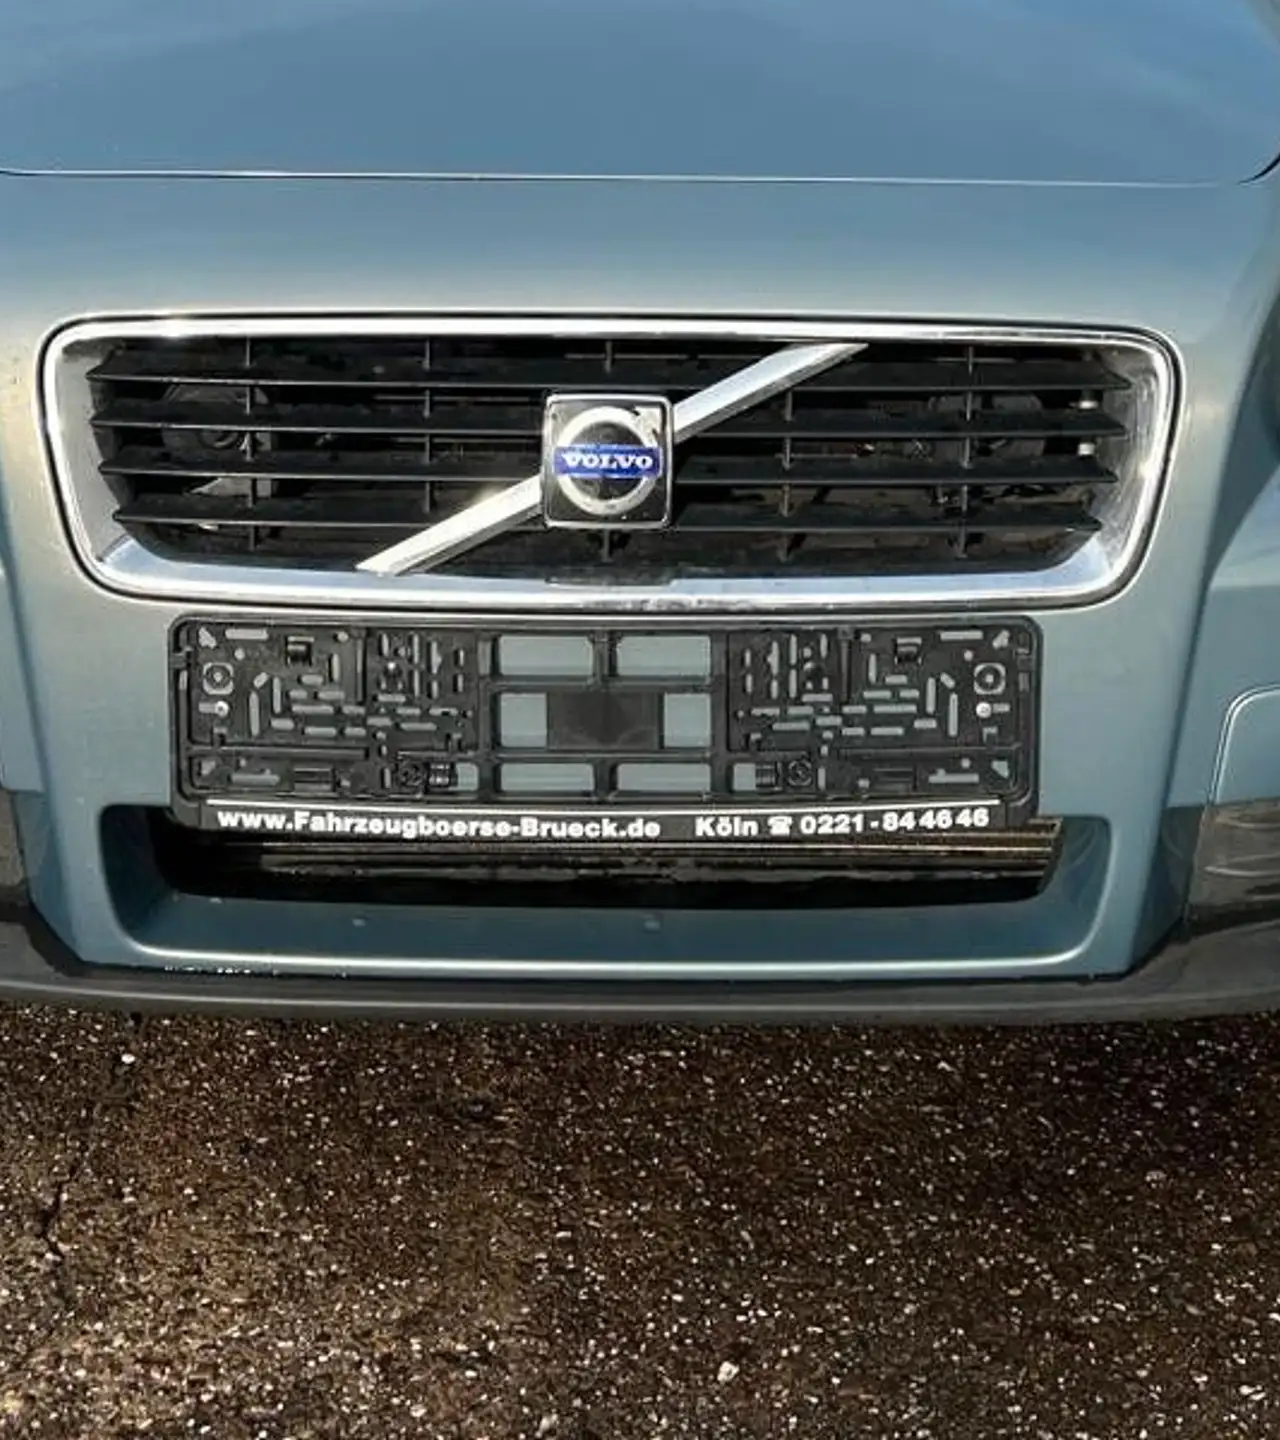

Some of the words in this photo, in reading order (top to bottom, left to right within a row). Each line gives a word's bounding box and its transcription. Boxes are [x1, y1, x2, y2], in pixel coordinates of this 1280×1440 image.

[561, 452, 653, 469] VOLVO
[217, 811, 661, 839] www.Fahrzeugboerse-Brueck.de
[695, 816, 759, 837] Köln
